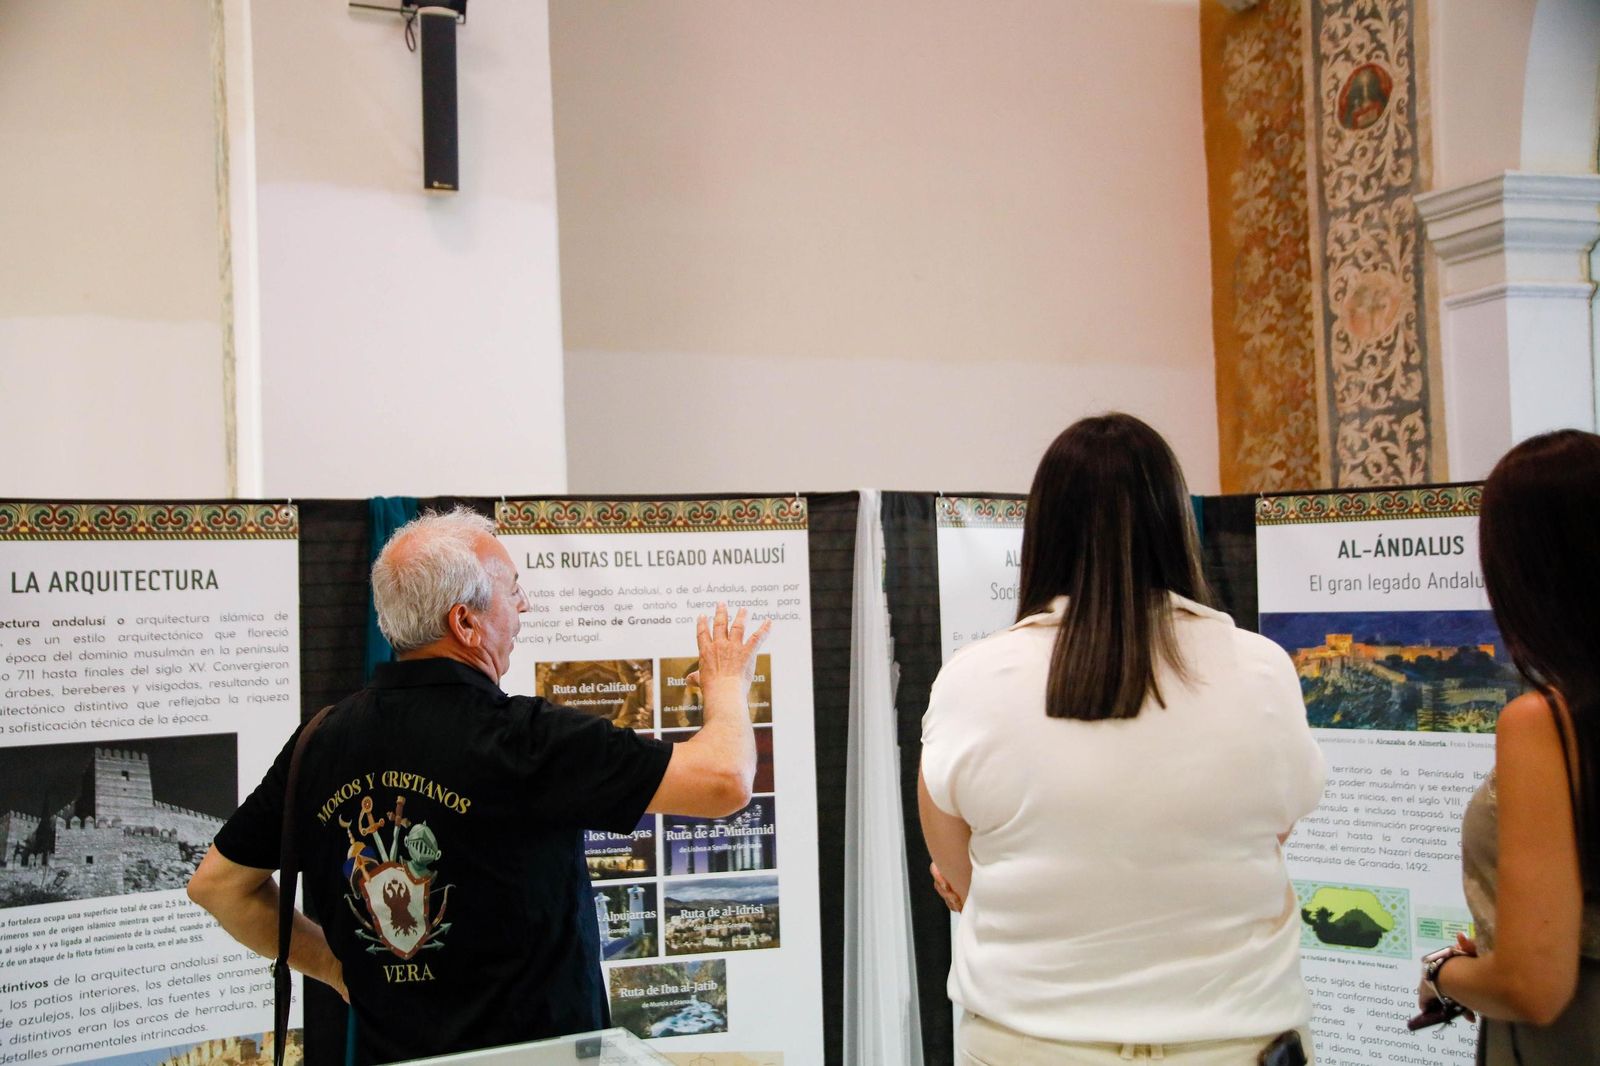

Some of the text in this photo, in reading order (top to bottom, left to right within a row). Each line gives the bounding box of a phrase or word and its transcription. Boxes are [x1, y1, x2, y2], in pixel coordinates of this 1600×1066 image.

[1337, 534, 1464, 559] AL-ÁNDALUS
[526, 543, 786, 569] LAS RUTAS DEL LEGADO ANDALUSÍ
[11, 569, 219, 595] LA ARQUITECTURA
[528, 584, 780, 598] rutas del legado pasan
[1310, 571, 1486, 595] El gran legado Andalu
[560, 598, 800, 612] senderos trazados para
[52, 616, 106, 627] andalusí
[136, 614, 210, 626] arquitectura
[220, 612, 264, 622] islámica
[274, 611, 288, 621] de
[578, 614, 693, 626] Reino de Granada con
[17, 627, 288, 646] es un estilo arquitectónico que floreció
[952, 632, 964, 641] En
[6, 643, 289, 664] época del dominio musulmán en la península
[18, 660, 289, 680] 711 hasta finales del siglo XV. Convergieron
[5, 676, 289, 699] árabes, bereberes y visigodas, resultando un
[552, 682, 637, 694] Ruta del Califato
[74, 702, 128, 713] distintivo
[136, 700, 160, 710] que
[168, 695, 220, 708] reflejaba
[228, 694, 239, 705] la
[246, 692, 290, 704] riqueza
[9, 712, 211, 734] sofisticación técnica de la época.
[1332, 766, 1464, 780] territorio de Península
[1338, 780, 1416, 791] poder musulmán
[317, 770, 472, 826] MOROS Y CRISTIANOS
[1324, 790, 1441, 806] En inicios, siglo
[1364, 806, 1444, 820] incluso traspasó
[666, 824, 774, 840] Ruta de al-Mutamid
[1332, 817, 1461, 834] una disminución progresiva
[588, 830, 606, 840] los
[1306, 828, 1448, 848] Nazarí hasta conquista
[1340, 844, 1412, 858] emirato Nazarí
[1287, 852, 1342, 865] Reconquista
[1344, 856, 1356, 866] de
[1358, 858, 1404, 871] Granada,
[8, 907, 118, 927] fortaleza ocupa superficie
[602, 910, 656, 924] Alpujarras
[680, 904, 764, 919] Ruta de al-Idrisi
[61, 925, 84, 934] origen
[29, 954, 55, 964] ataque
[54, 975, 70, 987] de
[75, 972, 86, 984] la
[91, 964, 166, 982] arquitectura
[170, 956, 220, 970] andalusí
[223, 953, 242, 964] son
[383, 963, 436, 984] VERA
[10, 973, 212, 1010] los patios interiores, los detalles
[620, 980, 718, 998] Ruta de Ibn al-Jatib
[1304, 974, 1410, 994] ocho siglos de historia
[19, 984, 246, 1027] azulejos, los aljibes, las fuentes los
[1316, 988, 1416, 1009] han conformado una
[1344, 1004, 1356, 1014] de
[10, 1000, 258, 1046] distintivos eran los arcos de herradura,
[52, 1023, 208, 1057] ornamentales intrincados.
[1360, 1034, 1423, 1052] gastronomía,
[1432, 1030, 1445, 1041] Su
[1329, 1044, 1382, 1060] idioma, las
